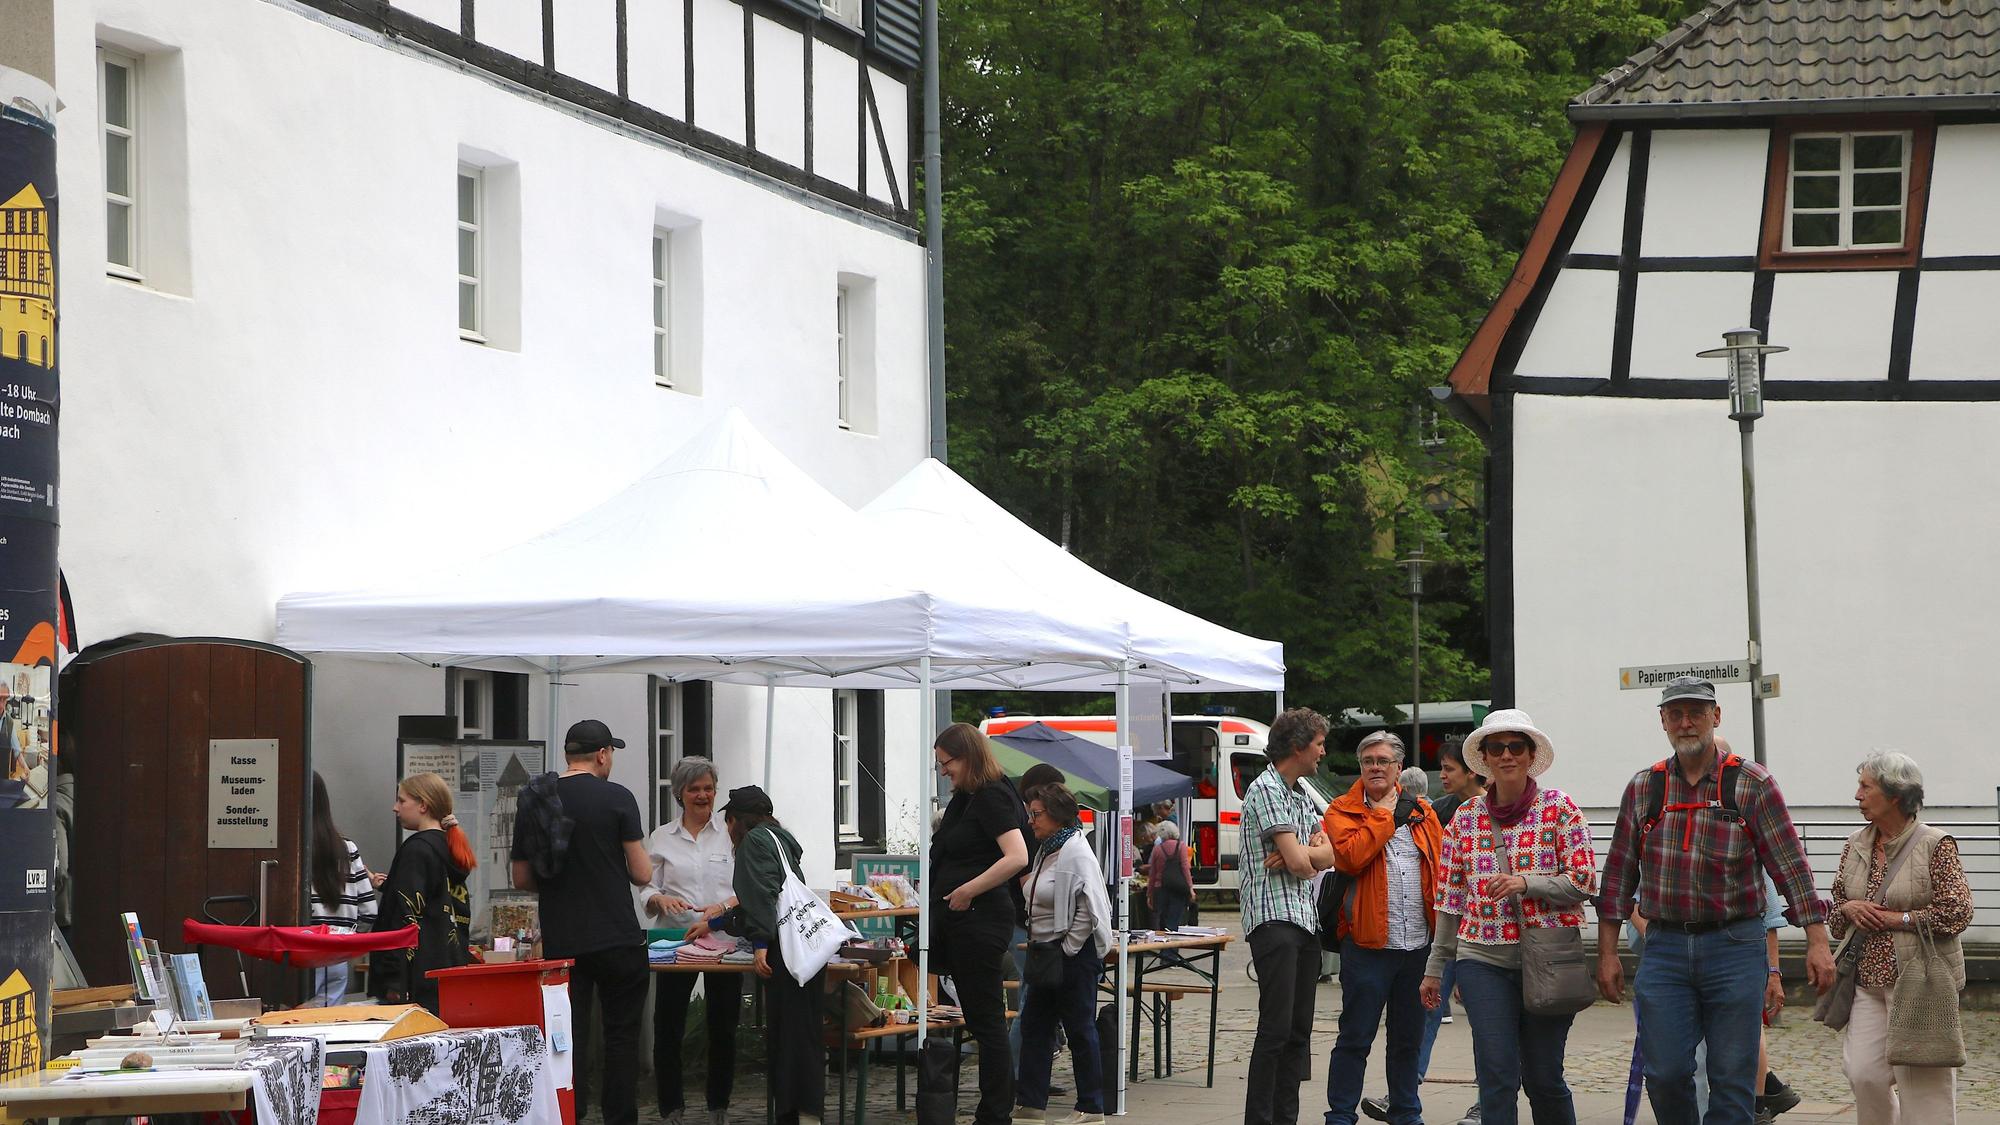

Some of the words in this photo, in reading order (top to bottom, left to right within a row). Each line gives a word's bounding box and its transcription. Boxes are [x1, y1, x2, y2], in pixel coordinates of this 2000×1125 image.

[16, 405, 51, 425] Dombach
[1638, 664, 1739, 685] Papiermaschinenhalle
[231, 756, 257, 765] Kasse
[221, 775, 266, 784] Museums-
[231, 786, 255, 795] laden
[226, 805, 260, 815] Sonder-
[217, 816, 269, 827] ausstellung
[28, 872, 40, 885] LVR
